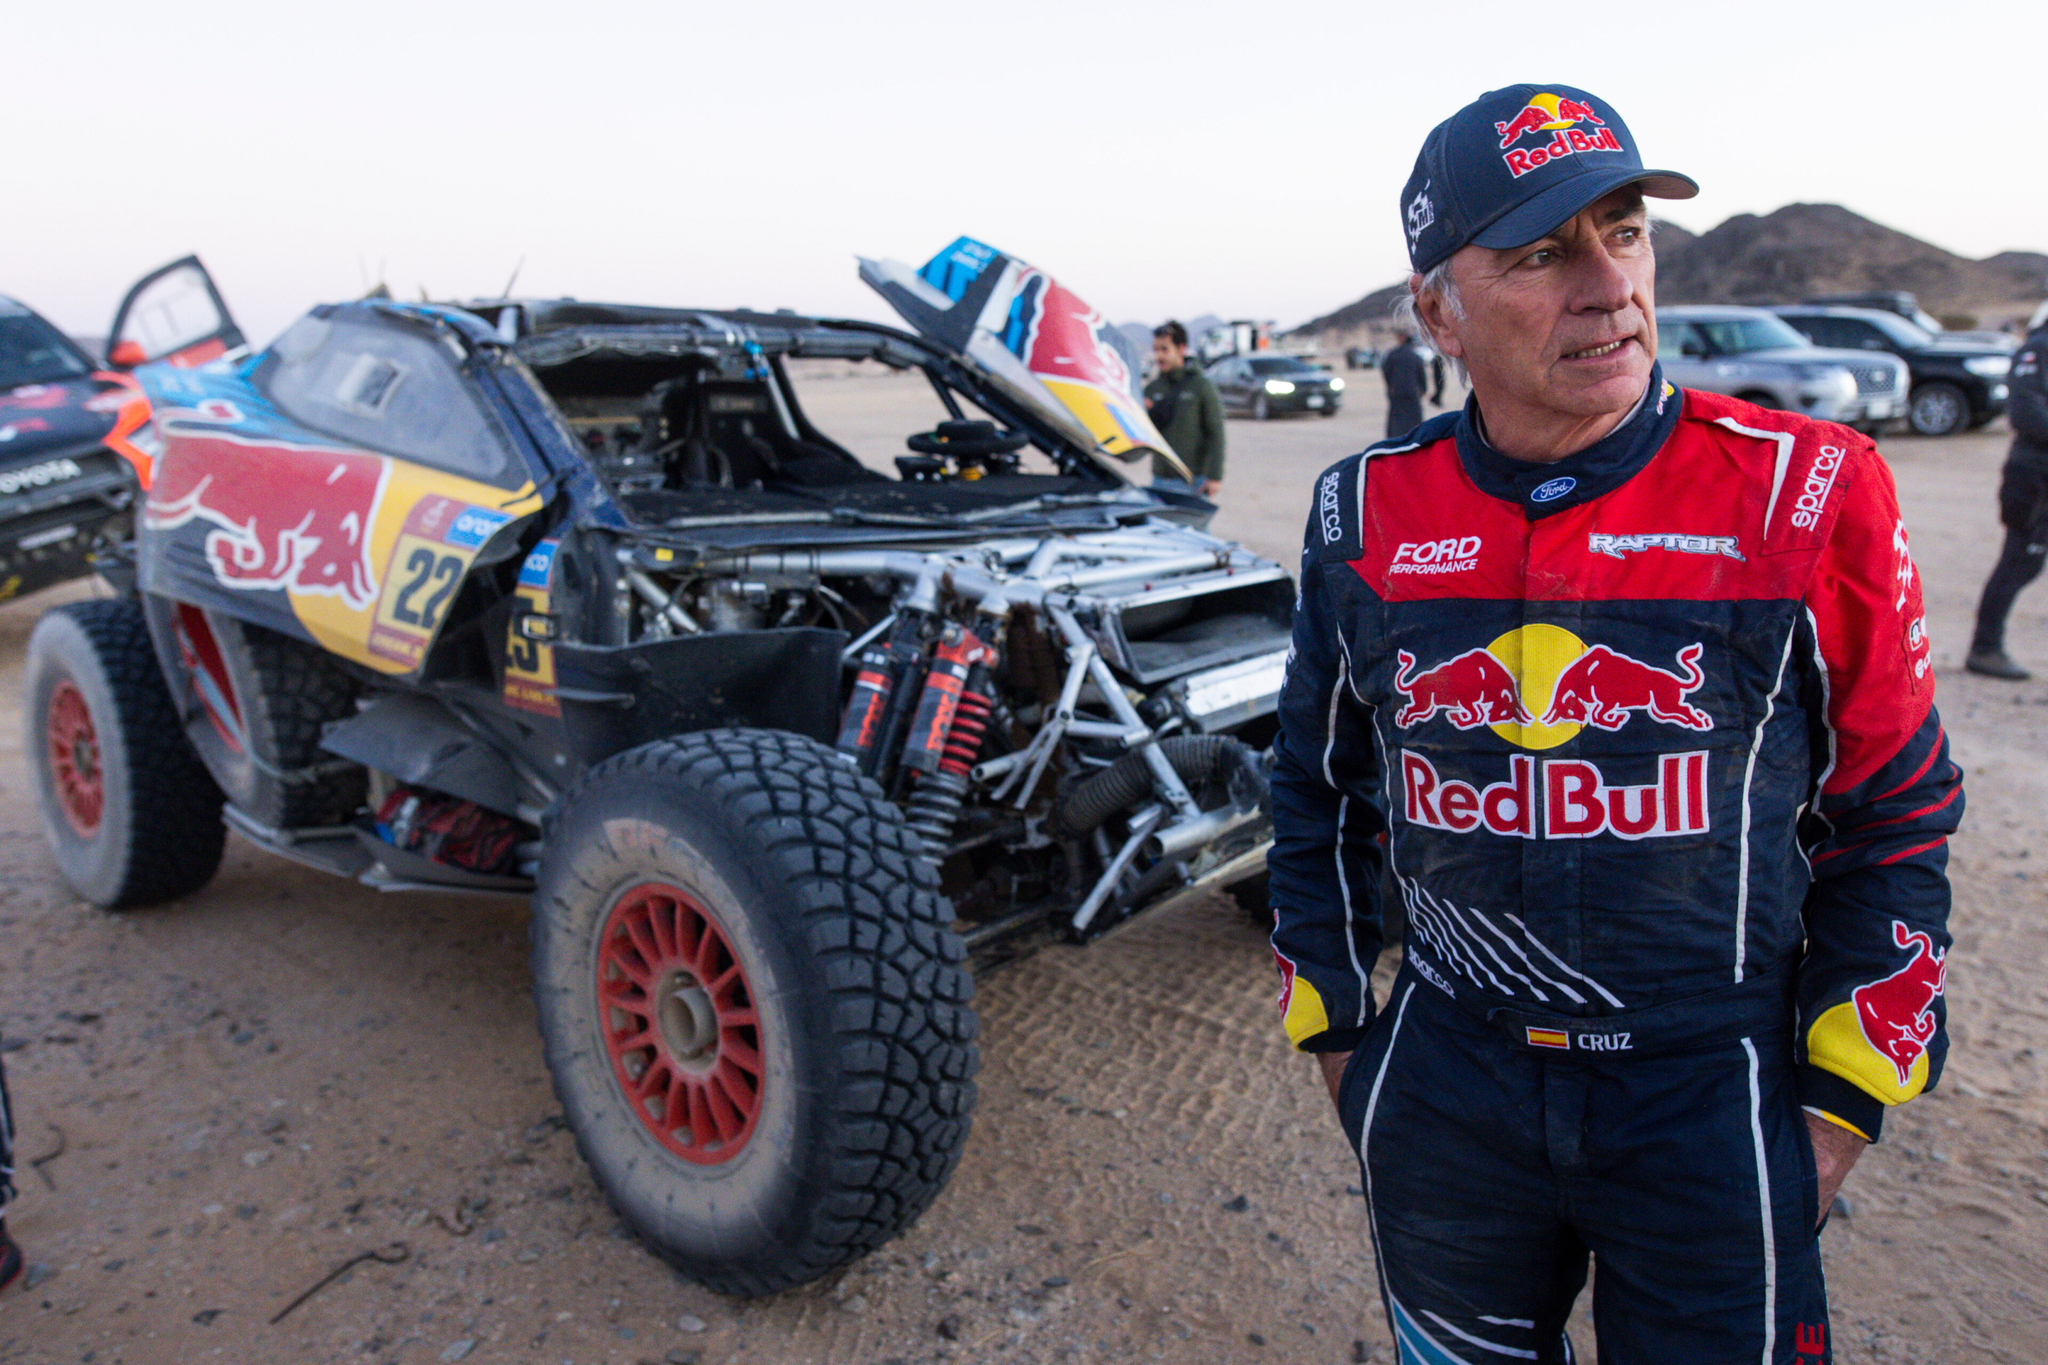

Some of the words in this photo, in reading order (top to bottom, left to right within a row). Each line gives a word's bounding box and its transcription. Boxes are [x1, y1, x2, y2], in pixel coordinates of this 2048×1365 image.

[1502, 130, 1574, 178] Red
[1566, 127, 1623, 152] Bull
[1320, 471, 1342, 545] sparco
[1538, 480, 1572, 500] Ford
[1791, 445, 1845, 532] sparco
[1388, 558, 1478, 576] PERFORMANCE
[1392, 535, 1482, 564] FORD
[1589, 533, 1746, 562] RAPTOR
[393, 548, 463, 629] 22
[1402, 748, 1535, 839] Red
[1543, 750, 1709, 840] Bull
[1408, 944, 1456, 999] sparco
[1578, 1032, 1633, 1051] CRUZ
